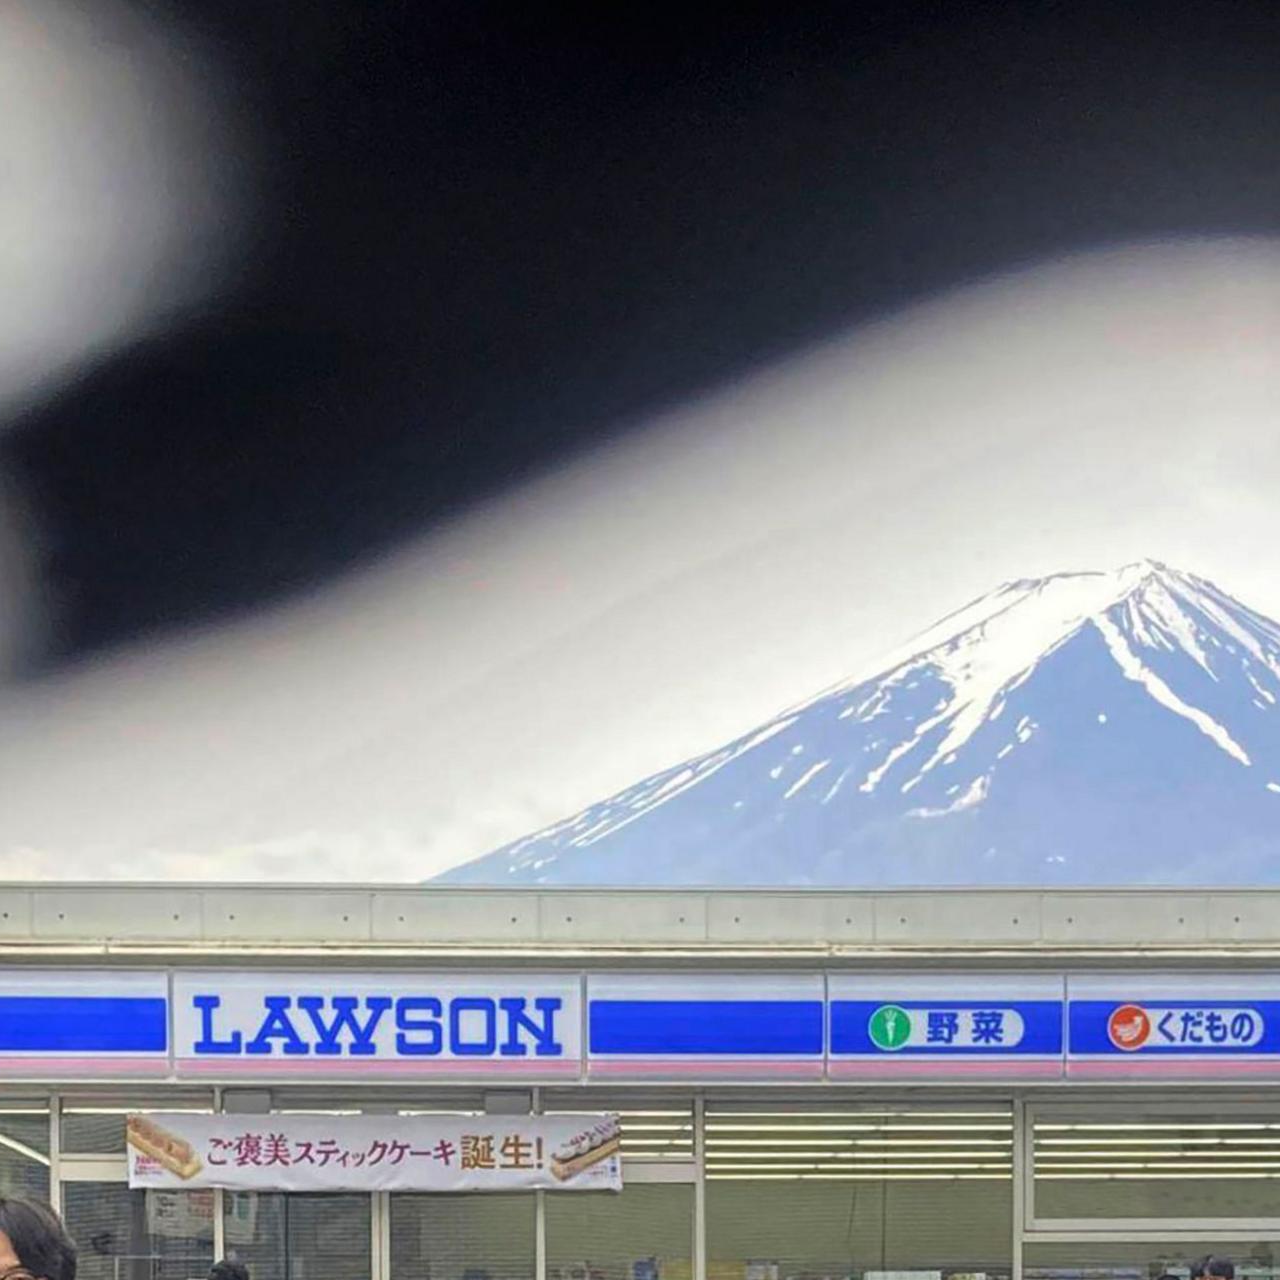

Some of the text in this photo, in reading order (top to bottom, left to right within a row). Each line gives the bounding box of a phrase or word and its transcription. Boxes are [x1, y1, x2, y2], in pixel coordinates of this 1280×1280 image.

[193, 996, 563, 1056] LAWSON
[926, 1011, 1005, 1044] 野菜
[1157, 1011, 1255, 1043] くだもの
